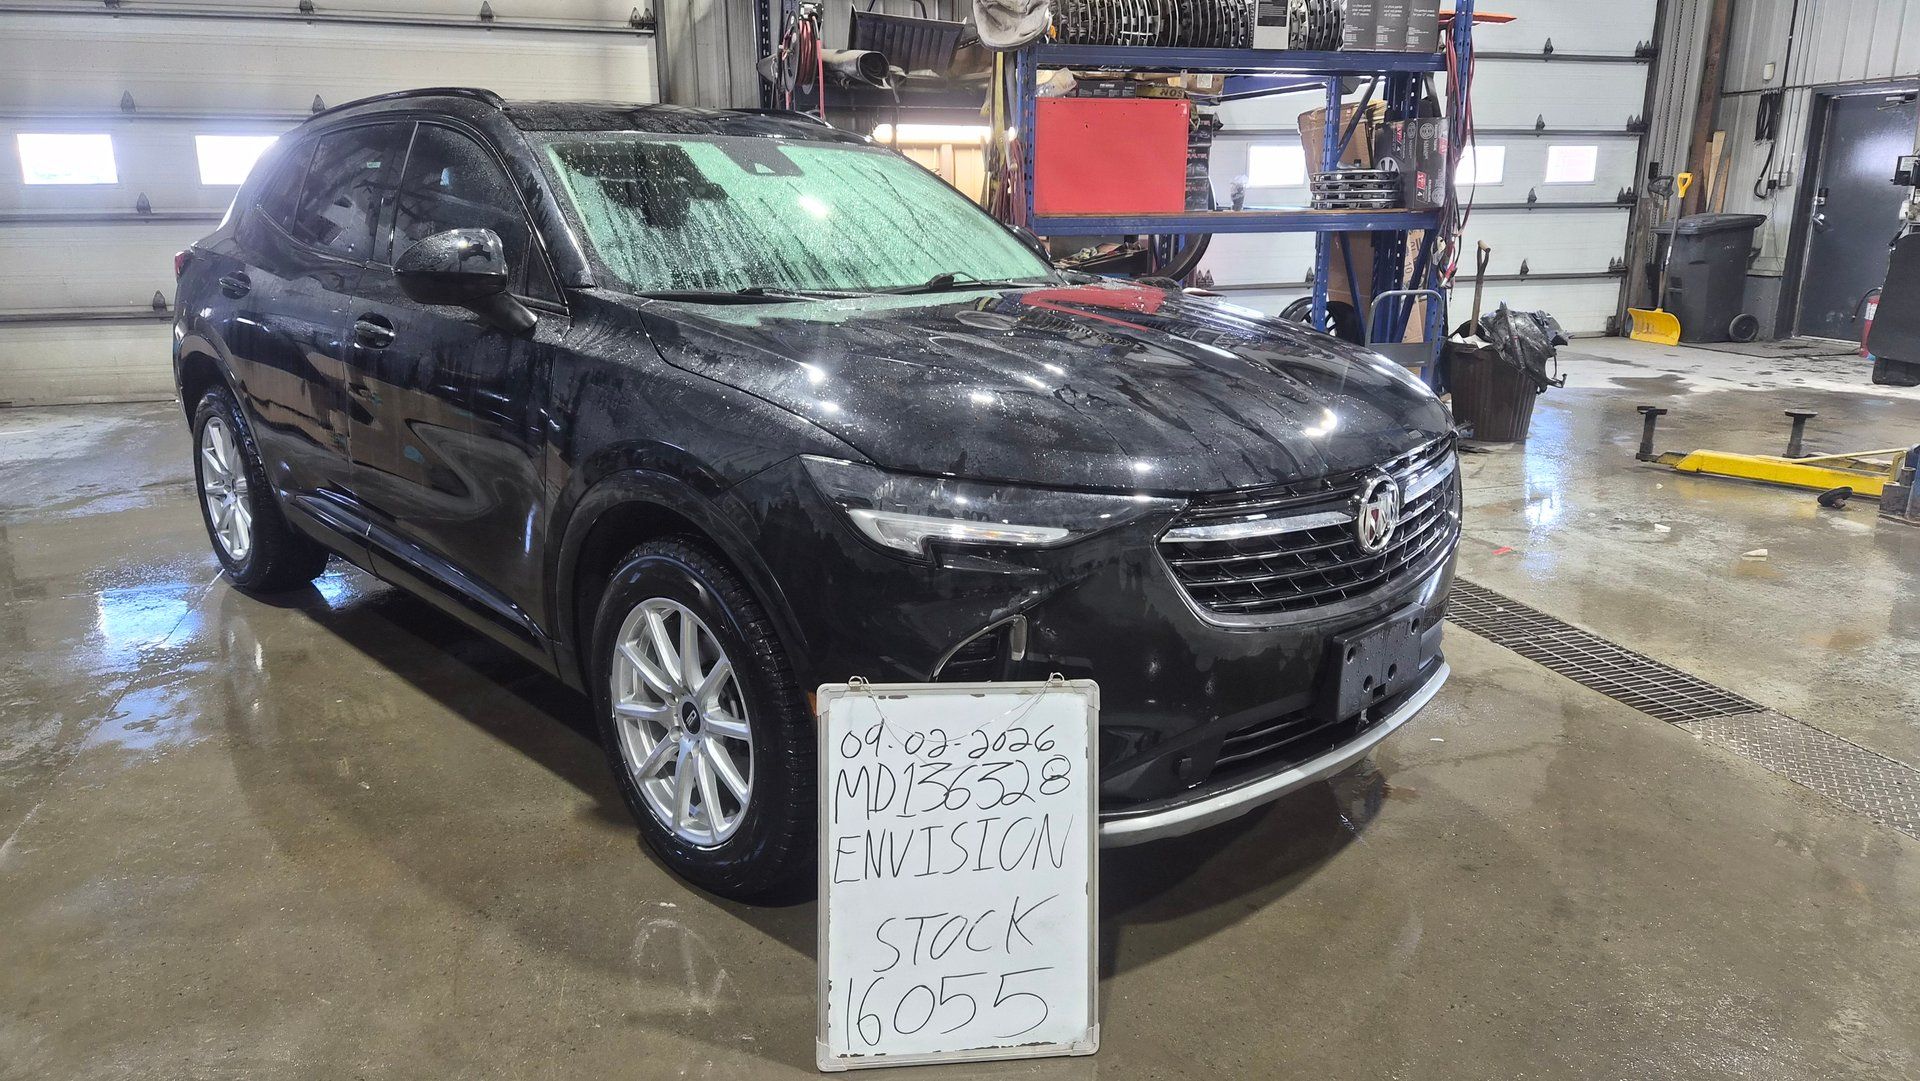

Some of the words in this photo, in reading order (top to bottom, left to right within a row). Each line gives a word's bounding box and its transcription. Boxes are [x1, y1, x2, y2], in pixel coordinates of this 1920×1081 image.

[835, 754, 1072, 824] MD136328
[834, 813, 1074, 884] ENVISION
[872, 894, 1059, 973] STOCK
[846, 966, 1055, 1050] 16055
